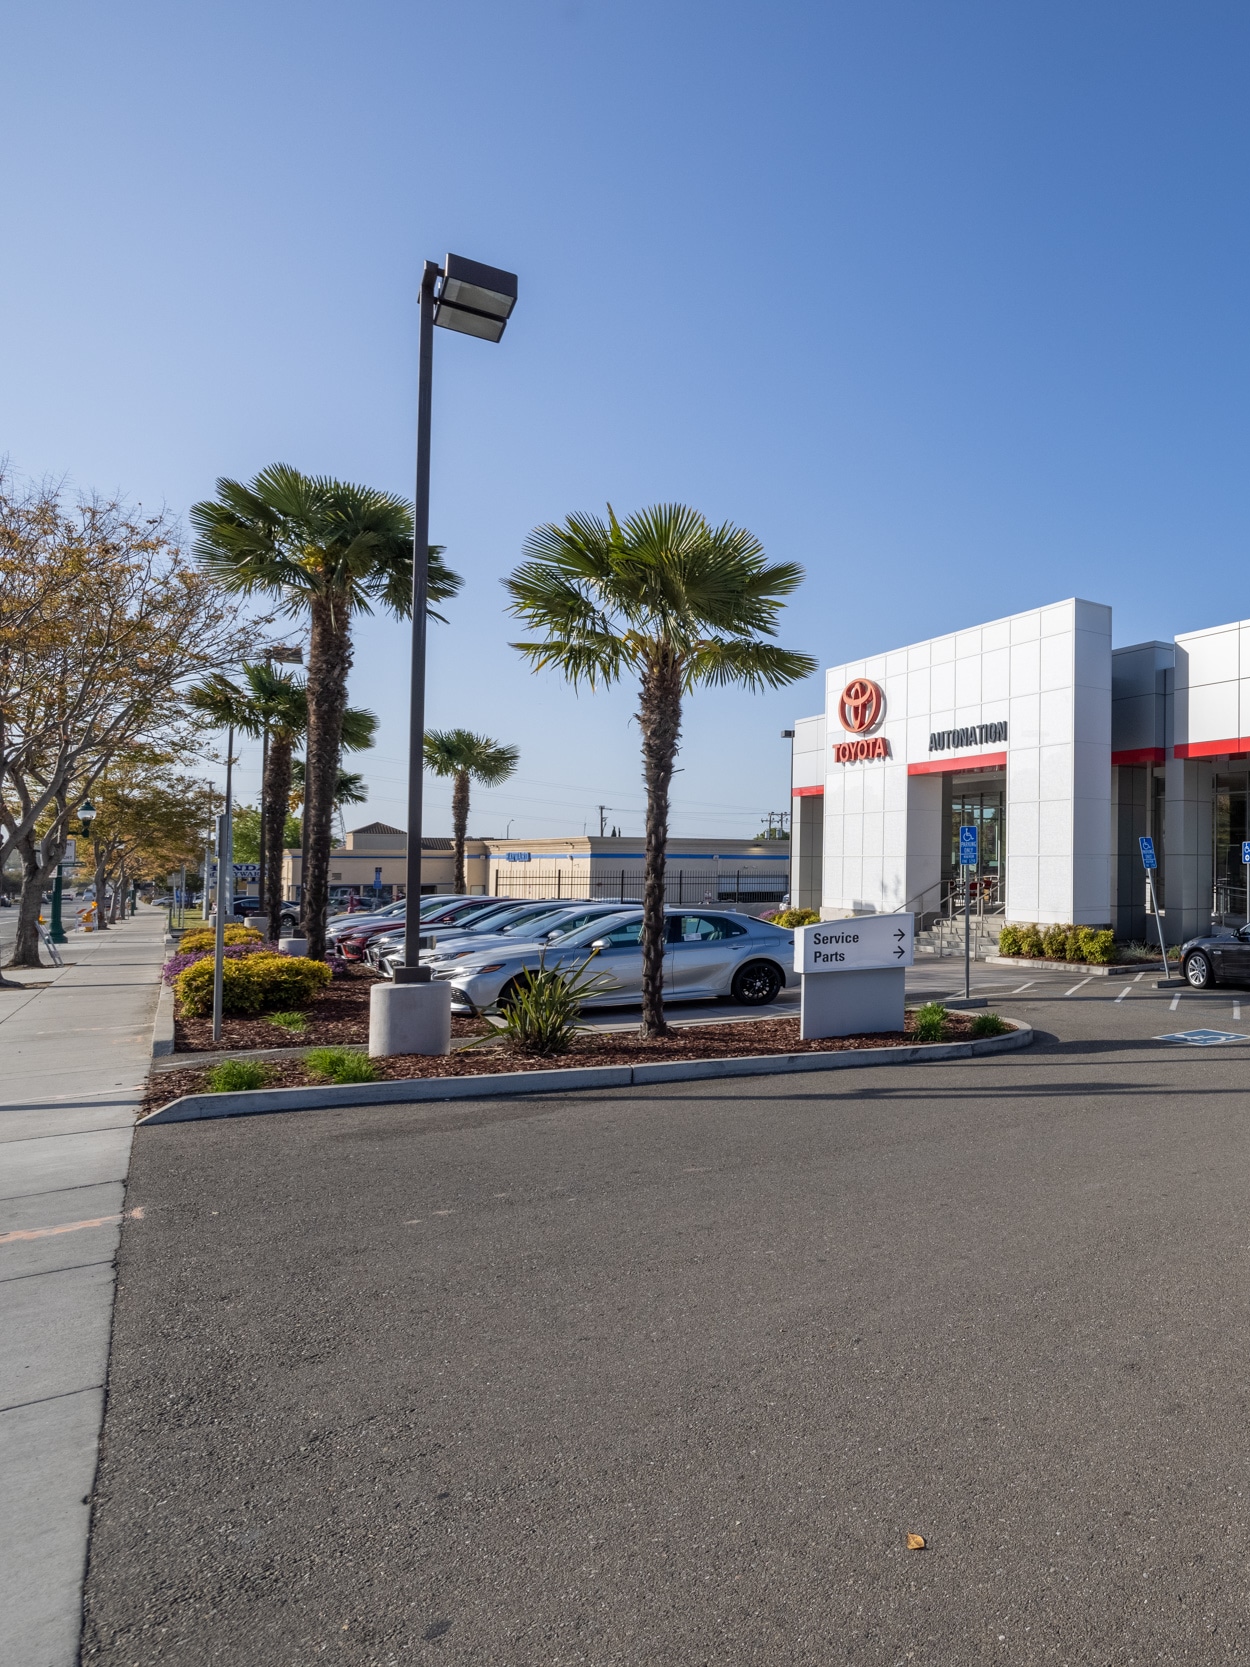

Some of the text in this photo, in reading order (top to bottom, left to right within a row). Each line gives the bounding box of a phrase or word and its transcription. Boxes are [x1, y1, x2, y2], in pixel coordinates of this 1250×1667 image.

[928, 721, 1008, 752] AUTONATION
[832, 737, 889, 763] TOYOTA
[813, 932, 860, 945] Service
[813, 951, 846, 963] Parts
